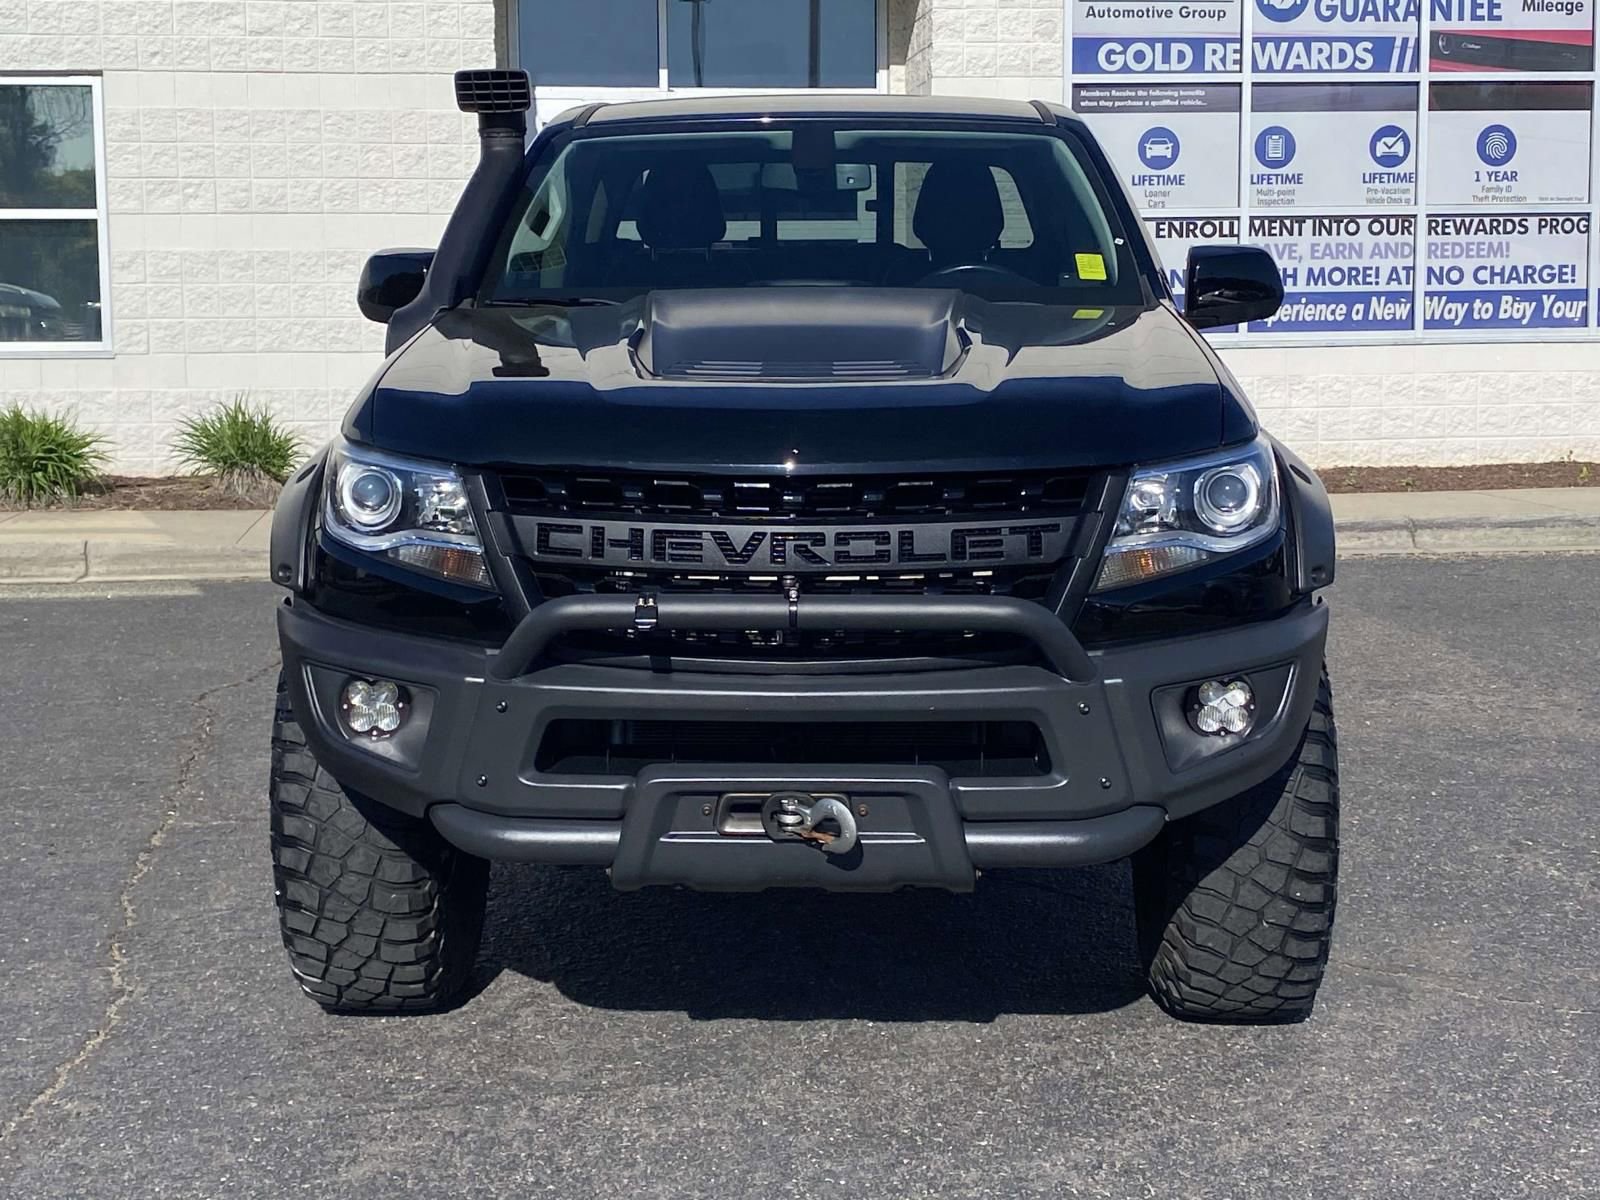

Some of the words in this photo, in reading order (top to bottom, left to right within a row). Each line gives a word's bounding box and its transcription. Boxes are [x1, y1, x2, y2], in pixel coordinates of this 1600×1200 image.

[1085, 6, 1173, 19] Automotive
[1179, 6, 1226, 21] Group
[1521, 0, 1584, 15] Mileage
[1097, 42, 1194, 72] GOLD
[1204, 41, 1374, 72] REWARDS
[1149, 90, 1178, 98] following
[1100, 100, 1113, 108] they
[1115, 100, 1143, 108] purchase
[1132, 174, 1185, 186] LIFETIME
[1250, 173, 1303, 185] LIFETIME
[1362, 172, 1415, 184] LIFETIME
[1474, 171, 1480, 182] 1
[1487, 171, 1518, 182] YEAR
[1144, 189, 1171, 198] Loaner
[1256, 188, 1296, 197] Multi-point
[1366, 187, 1411, 195] Pre-Vacation
[1481, 185, 1504, 193] Family
[1148, 200, 1166, 208] Cars
[1257, 198, 1295, 206] Inspection
[1386, 196, 1403, 204] Check
[1312, 218, 1360, 237] INTO
[1368, 218, 1413, 236] OUR
[1427, 218, 1529, 236] REWARDS
[1538, 217, 1589, 235] PROG
[1257, 242, 1303, 263] AVE,
[1310, 242, 1363, 260] EARN
[1369, 242, 1413, 260] AND
[1427, 241, 1510, 259] REDEEM!
[1306, 266, 1380, 286] MORE!
[1386, 266, 1415, 286] AT
[1426, 265, 1464, 286] NO
[1472, 264, 1576, 285] CHARGE!
[1263, 297, 1347, 327] perience
[1351, 303, 1364, 321] a
[1368, 296, 1411, 321] New
[1425, 295, 1469, 326] Way
[1472, 299, 1494, 320] to
[1498, 295, 1537, 325] Buy
[1541, 294, 1587, 321] Your
[536, 521, 1061, 566] CHEVROLET
